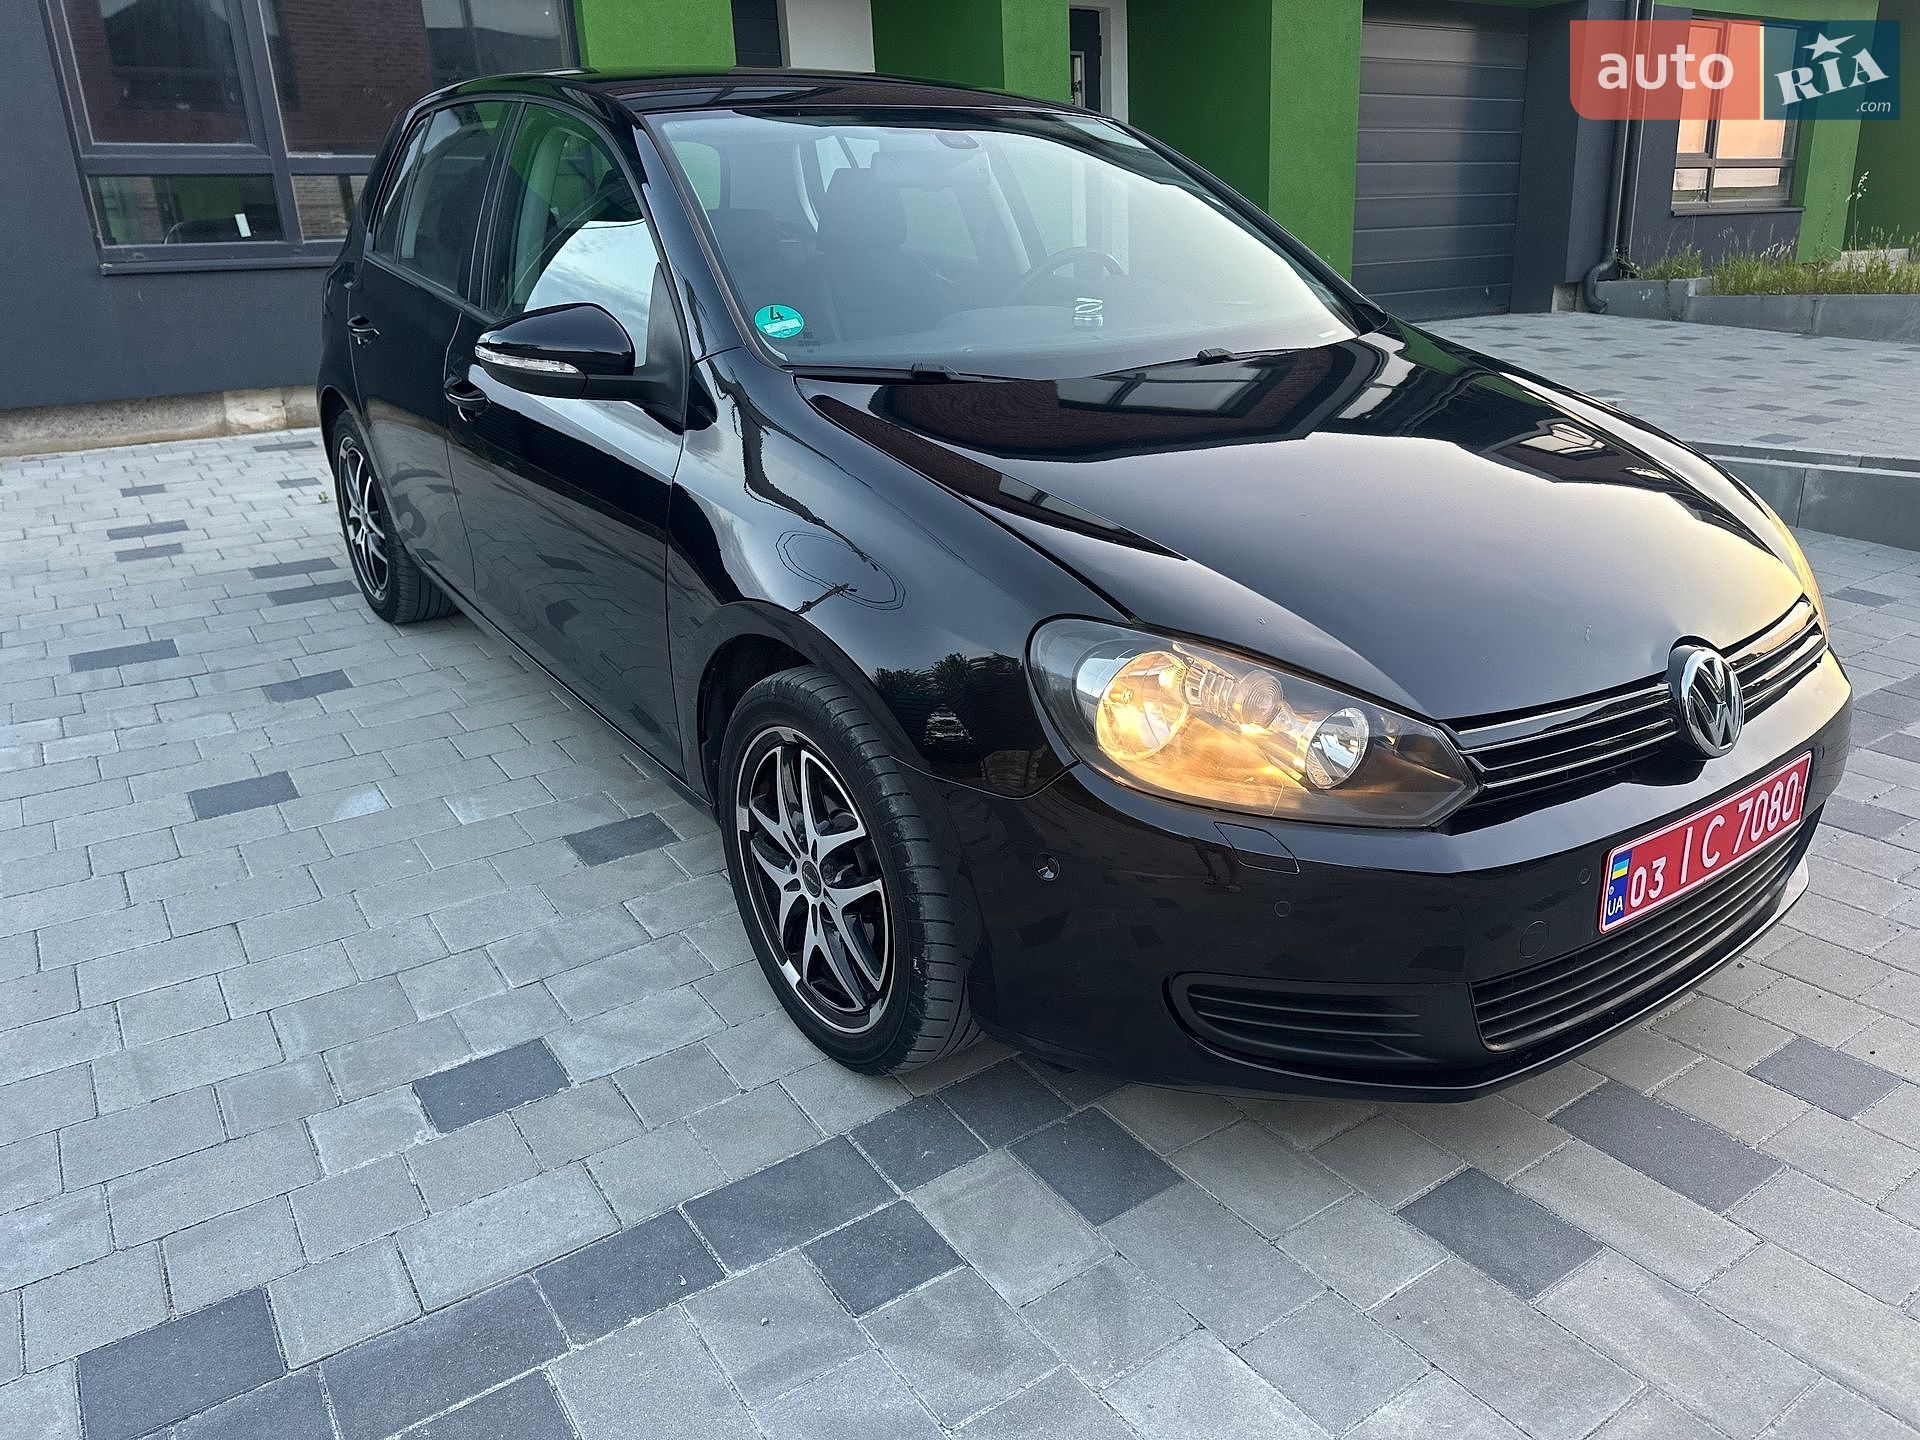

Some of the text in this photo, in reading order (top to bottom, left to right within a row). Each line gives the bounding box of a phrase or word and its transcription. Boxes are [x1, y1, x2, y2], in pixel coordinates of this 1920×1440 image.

[1630, 856, 1667, 908] 03
[1732, 771, 1799, 855] 7080
[1607, 895, 1623, 917] UA
